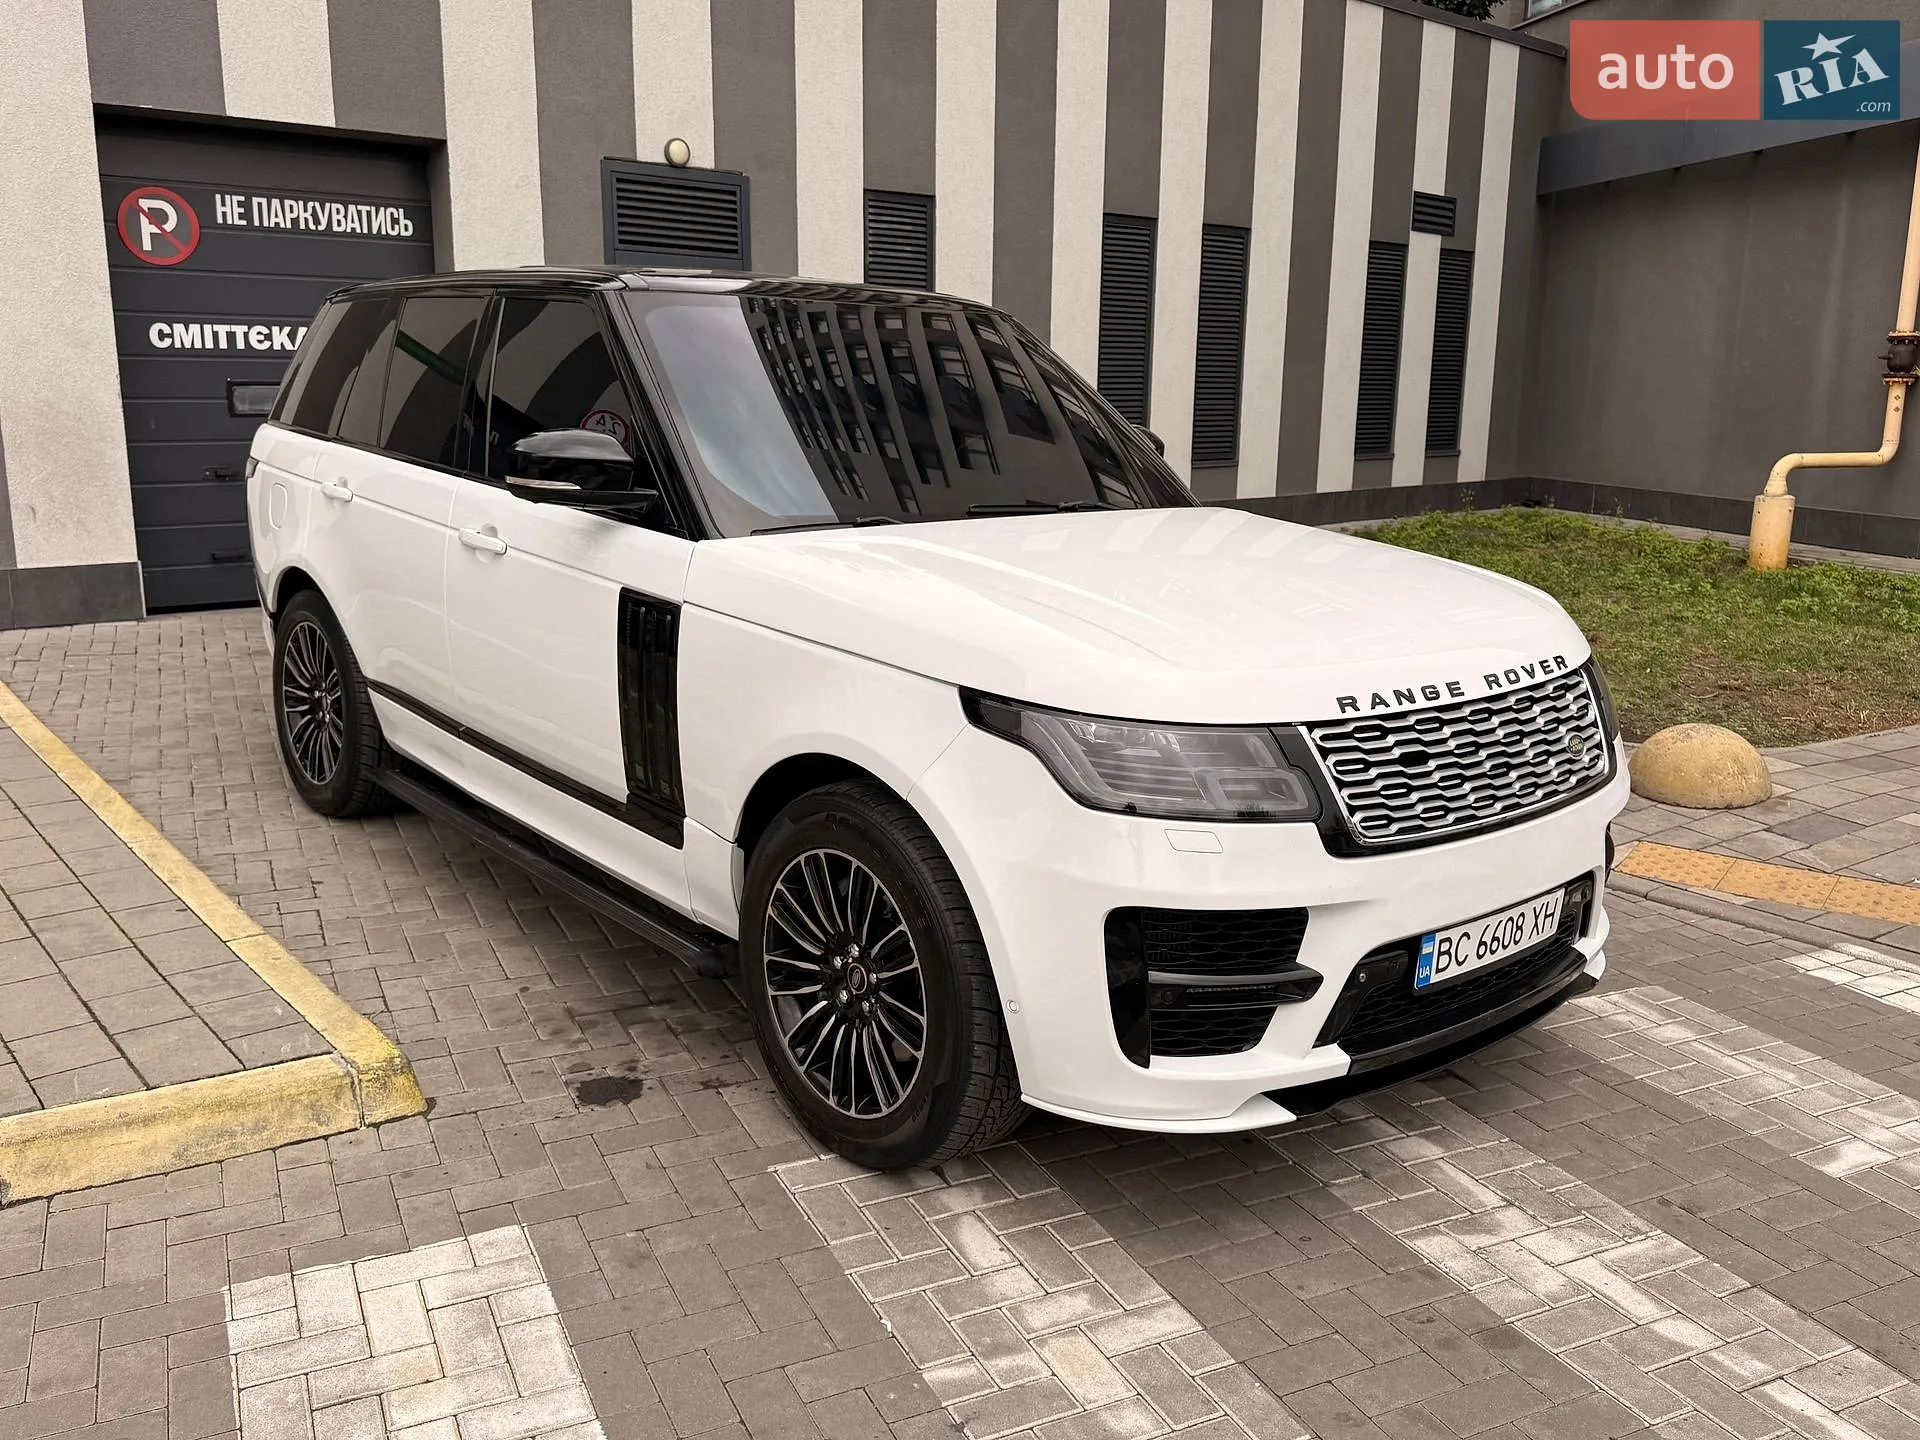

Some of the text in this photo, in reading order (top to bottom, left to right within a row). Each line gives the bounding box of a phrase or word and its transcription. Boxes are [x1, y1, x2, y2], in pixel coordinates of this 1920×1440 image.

[138, 198, 178, 251] P
[215, 193, 413, 237] НЕ ПАРКУВАТИСЬ
[1336, 655, 1568, 713] RANGE ROVER
[1435, 897, 1559, 975] BC 6608 XH
[1419, 967, 1431, 979] UA
